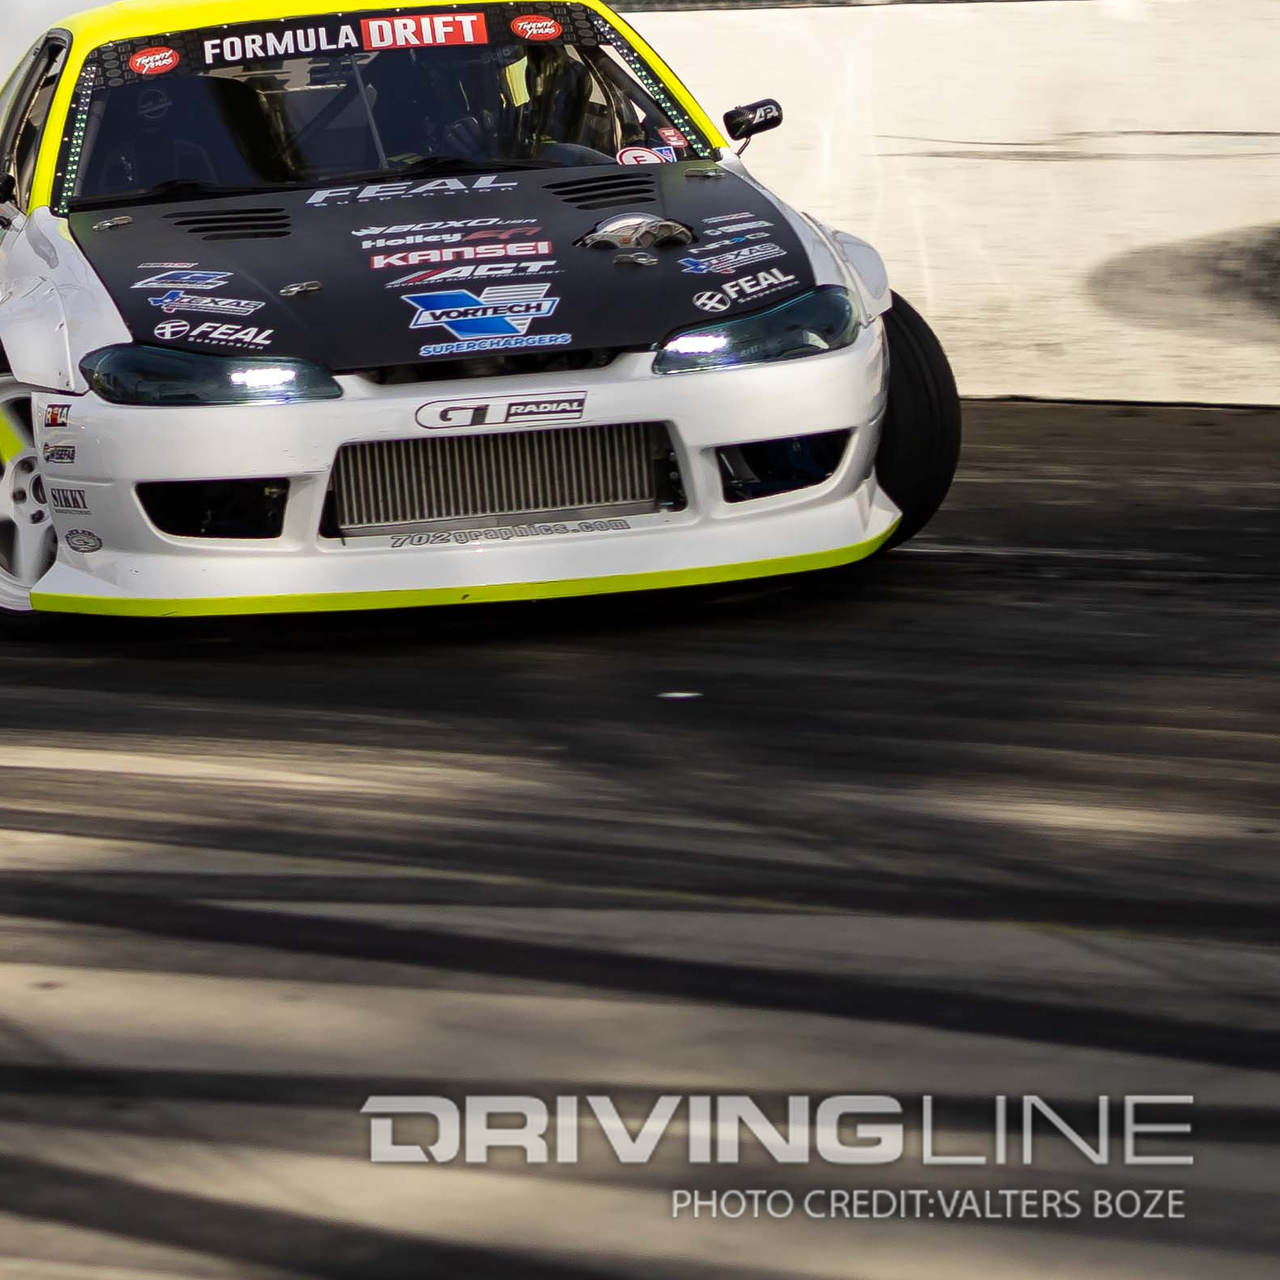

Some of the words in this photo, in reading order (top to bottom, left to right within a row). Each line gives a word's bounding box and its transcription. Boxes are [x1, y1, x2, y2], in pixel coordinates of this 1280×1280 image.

[204, 25, 359, 63] FORMULA
[371, 15, 478, 48] DRIFT
[305, 175, 519, 205] FEAL
[361, 232, 465, 250] Holley
[721, 267, 795, 300] FEAL
[428, 302, 543, 321] VORTECH
[189, 322, 275, 345] FEAL
[419, 333, 572, 357] SUPERCHARGERS
[509, 401, 583, 415] RADIAL
[50, 488, 88, 509] SIKKY
[390, 519, 632, 548] 702graphics.com
